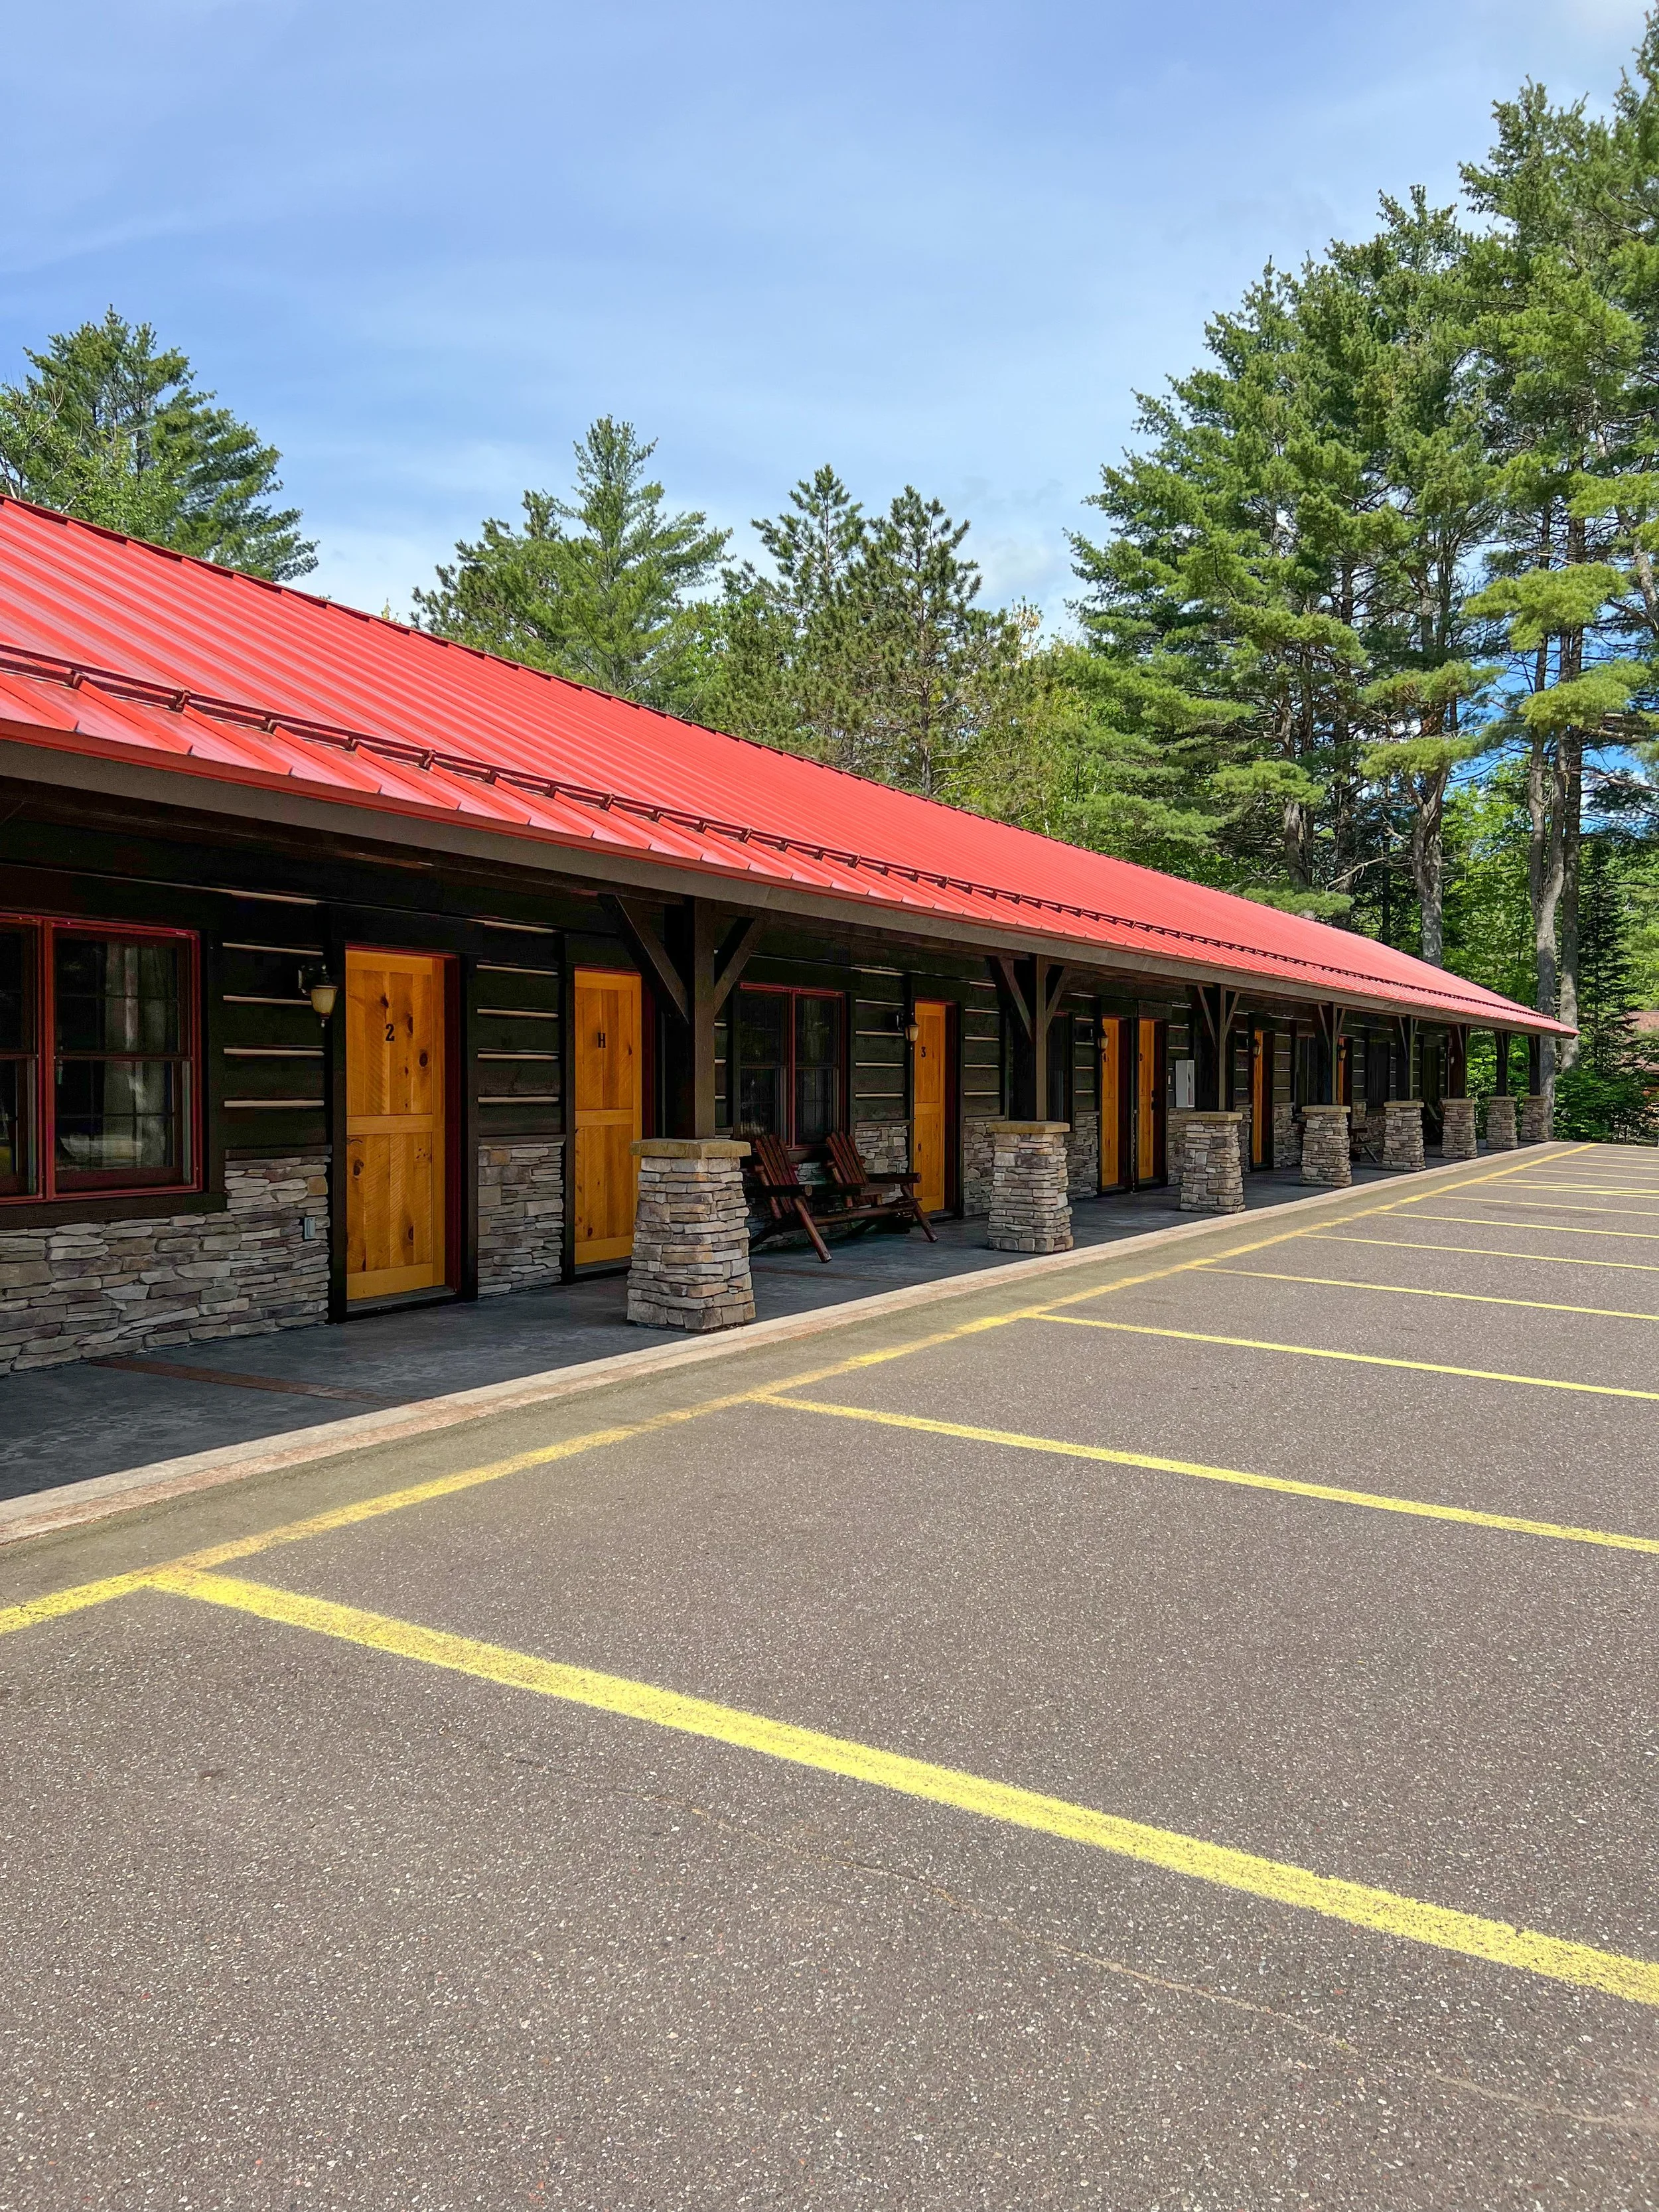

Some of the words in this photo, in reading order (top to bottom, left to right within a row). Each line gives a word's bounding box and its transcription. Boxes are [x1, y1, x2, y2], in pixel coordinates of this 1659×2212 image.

[386, 1023, 395, 1041] 2
[597, 1032, 606, 1048] H
[921, 1047, 926, 1058] 3
